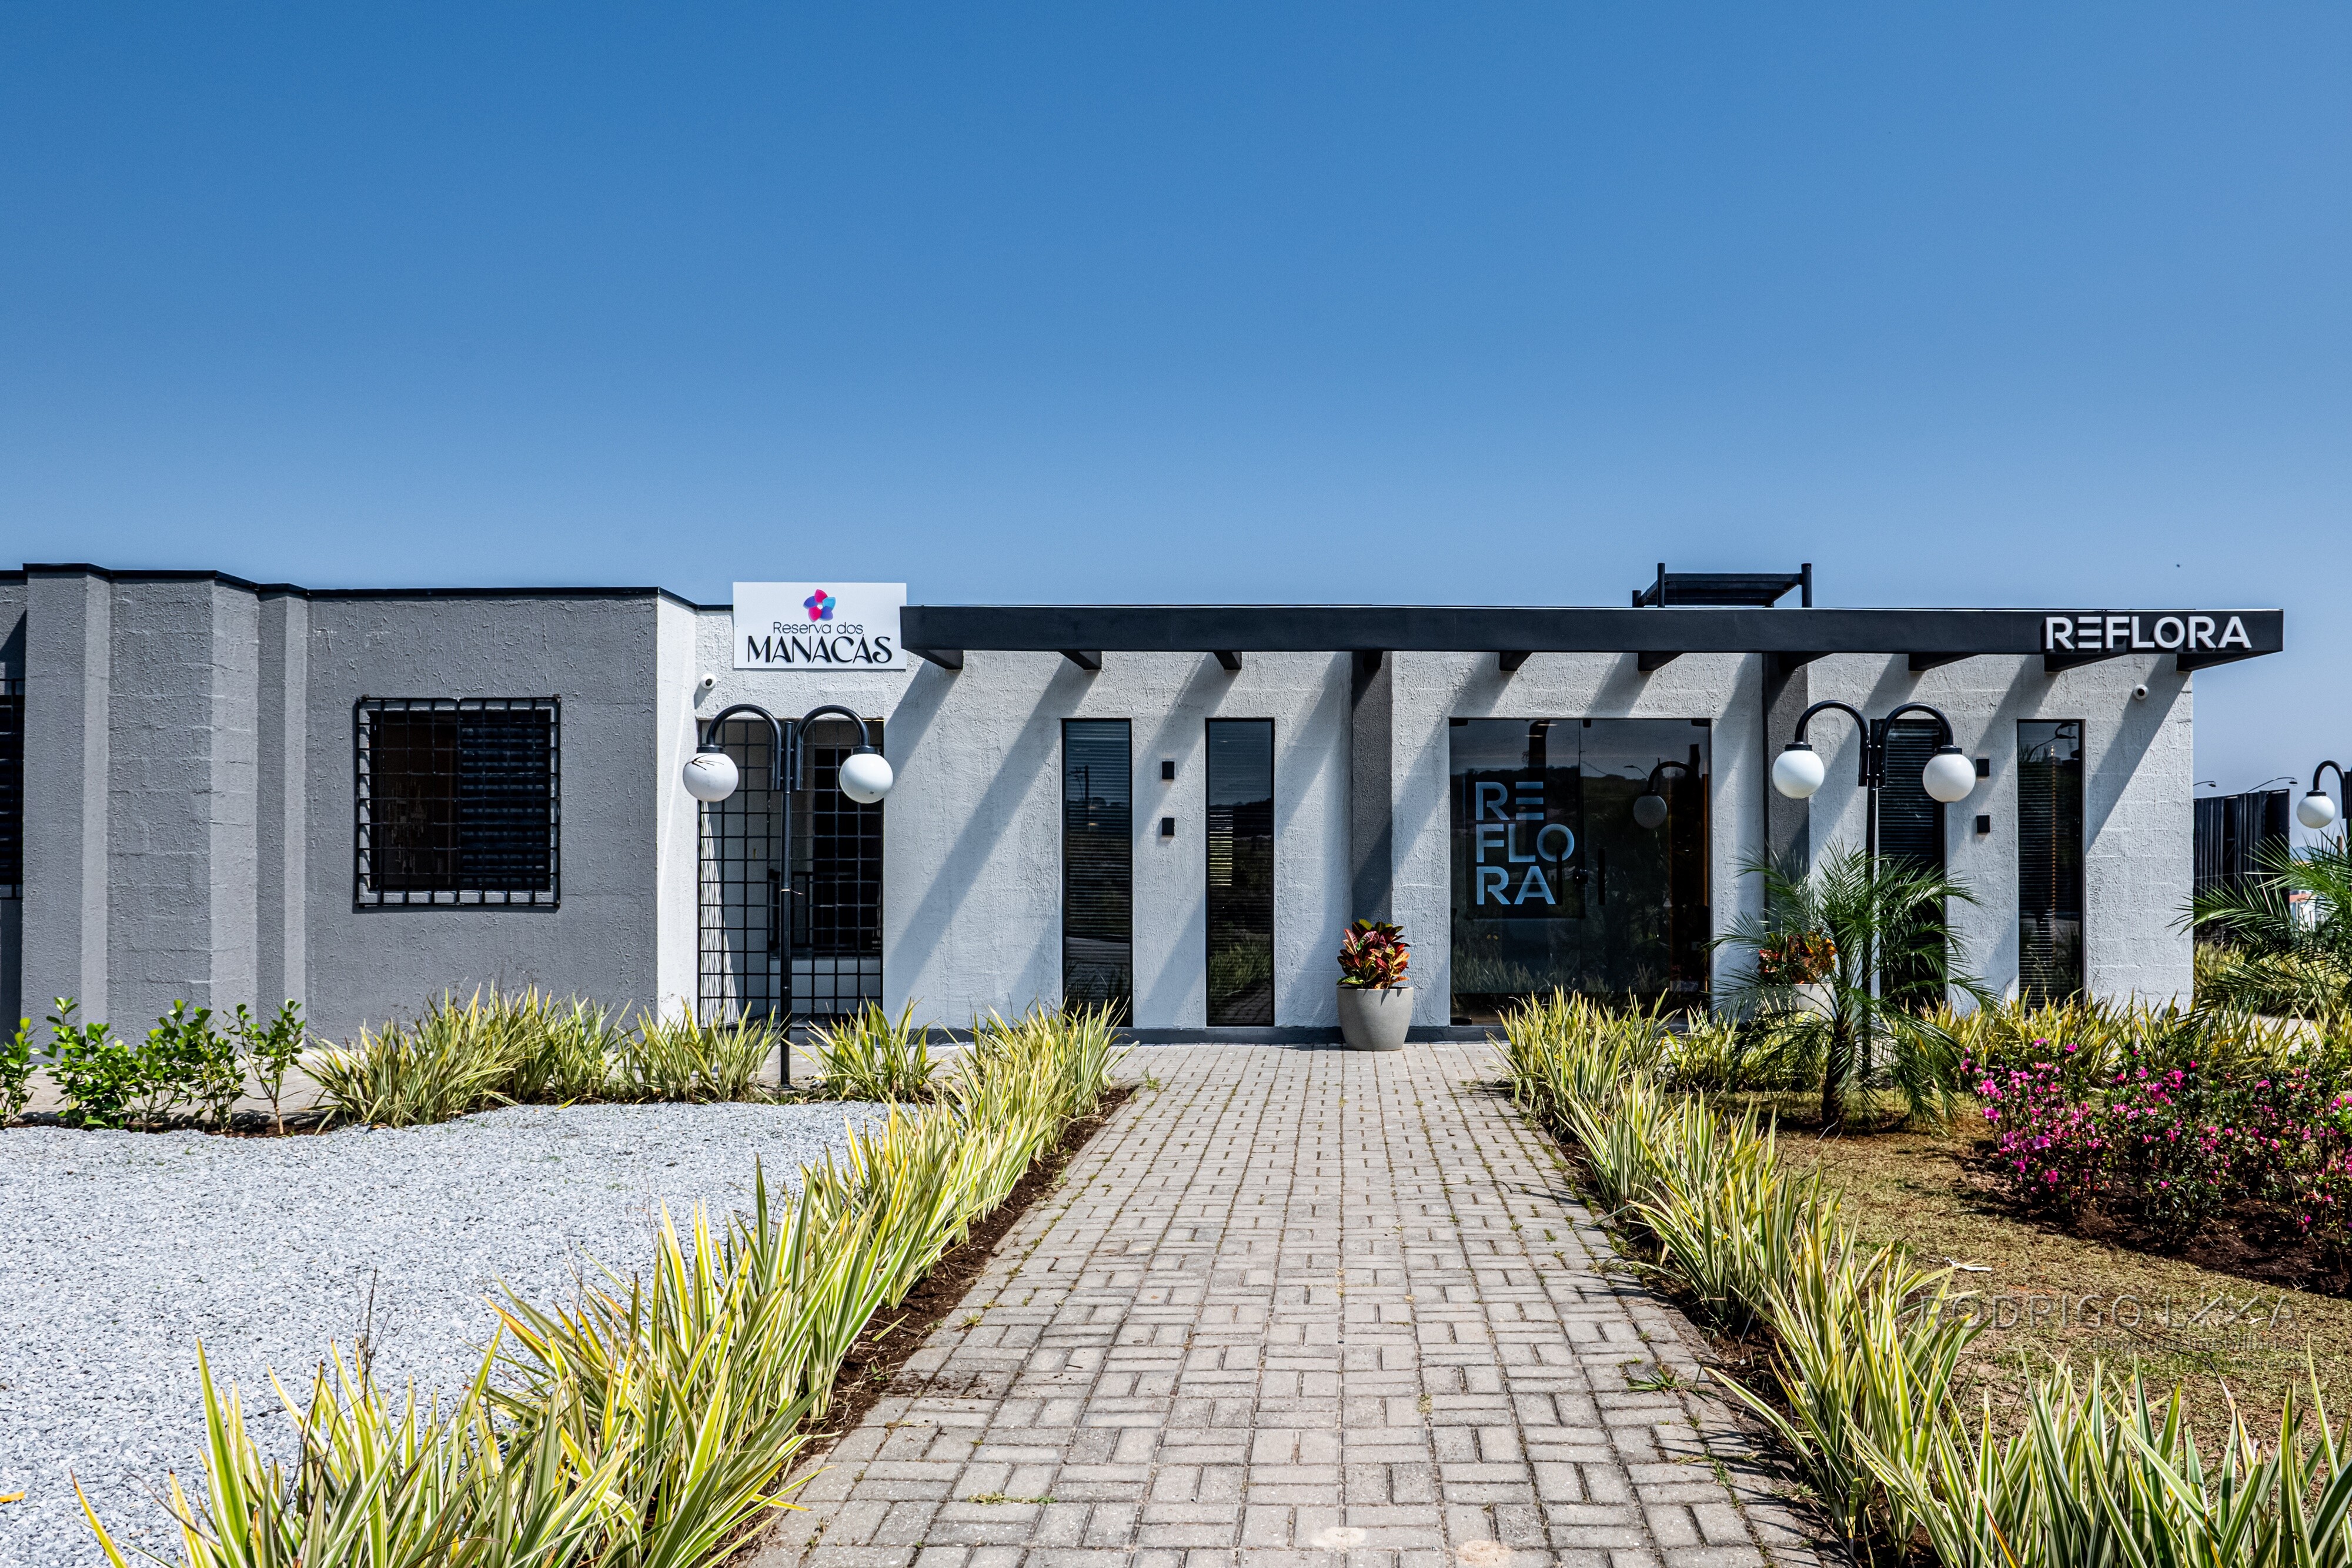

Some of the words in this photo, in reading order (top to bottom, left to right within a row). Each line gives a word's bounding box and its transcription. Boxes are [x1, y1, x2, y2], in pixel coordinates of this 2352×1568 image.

[773, 621, 831, 634] Reserva
[837, 621, 863, 634] dos
[2046, 616, 2252, 649] REFLORA
[747, 633, 893, 664] MANACÁS
[1475, 782, 1544, 820] RE
[1476, 823, 1575, 863] FLO
[1476, 865, 1556, 905] RA
